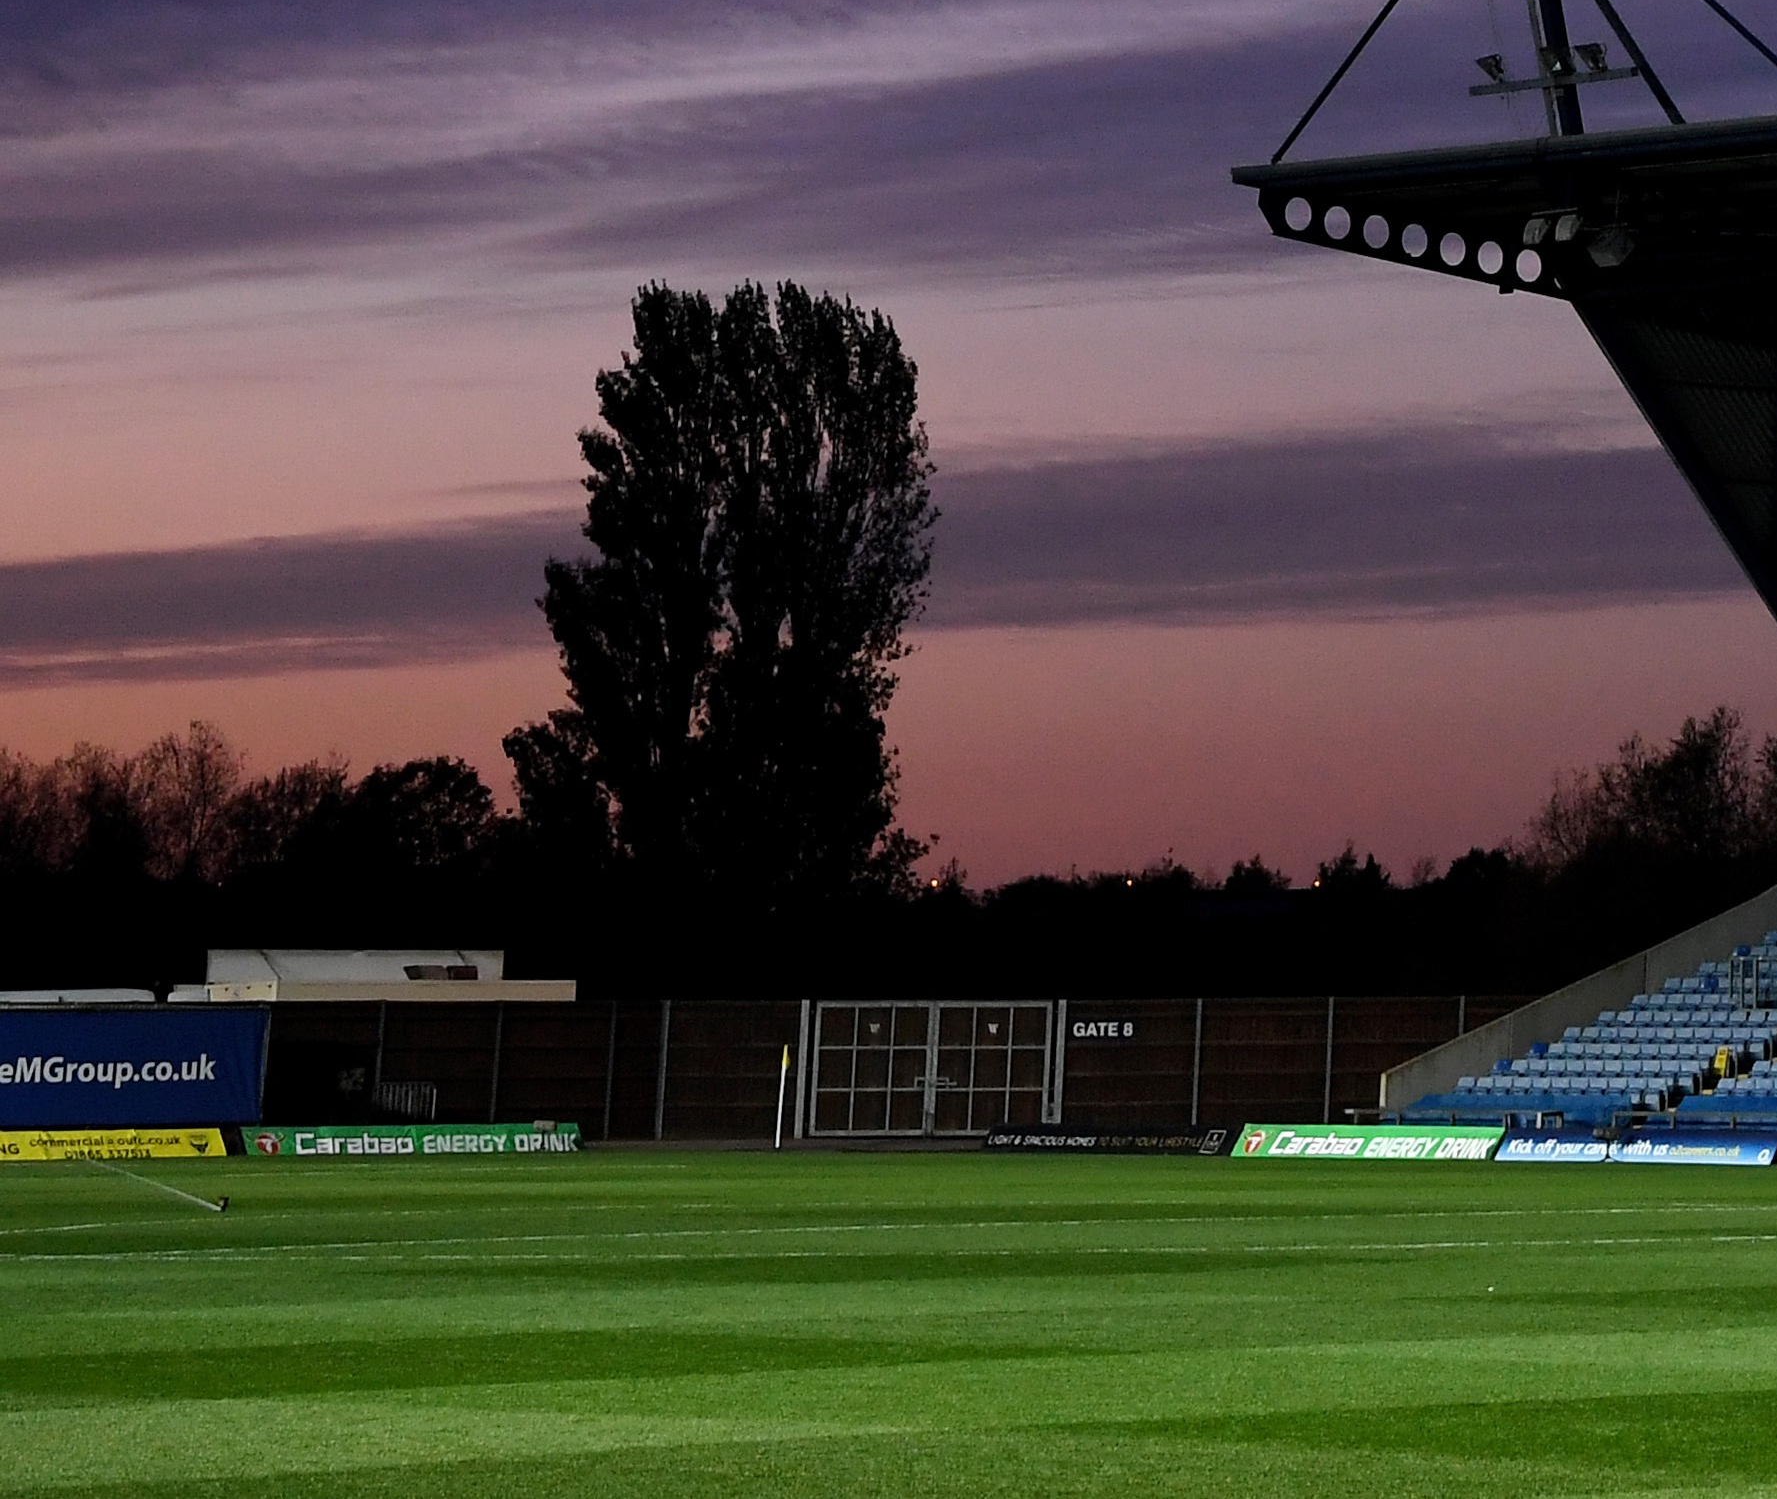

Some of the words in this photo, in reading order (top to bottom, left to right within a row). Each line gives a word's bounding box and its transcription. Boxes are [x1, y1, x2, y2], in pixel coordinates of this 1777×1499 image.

[1072, 1021, 1119, 1038] GATE
[1122, 1021, 1134, 1038] 8
[0, 1053, 216, 1089] eMGroup.co.uk
[294, 1132, 414, 1156] Carabao
[422, 1132, 508, 1155] ENERGY
[513, 1132, 578, 1154] DRINK
[1267, 1130, 1365, 1156] Carabao
[1363, 1136, 1438, 1158] ENERGY
[1434, 1137, 1497, 1159] DRINK
[1507, 1138, 1534, 1154] Kick
[1534, 1138, 1558, 1154] off
[1551, 1142, 1585, 1158] your
[1623, 1139, 1652, 1155] with
[1653, 1143, 1669, 1156] us
